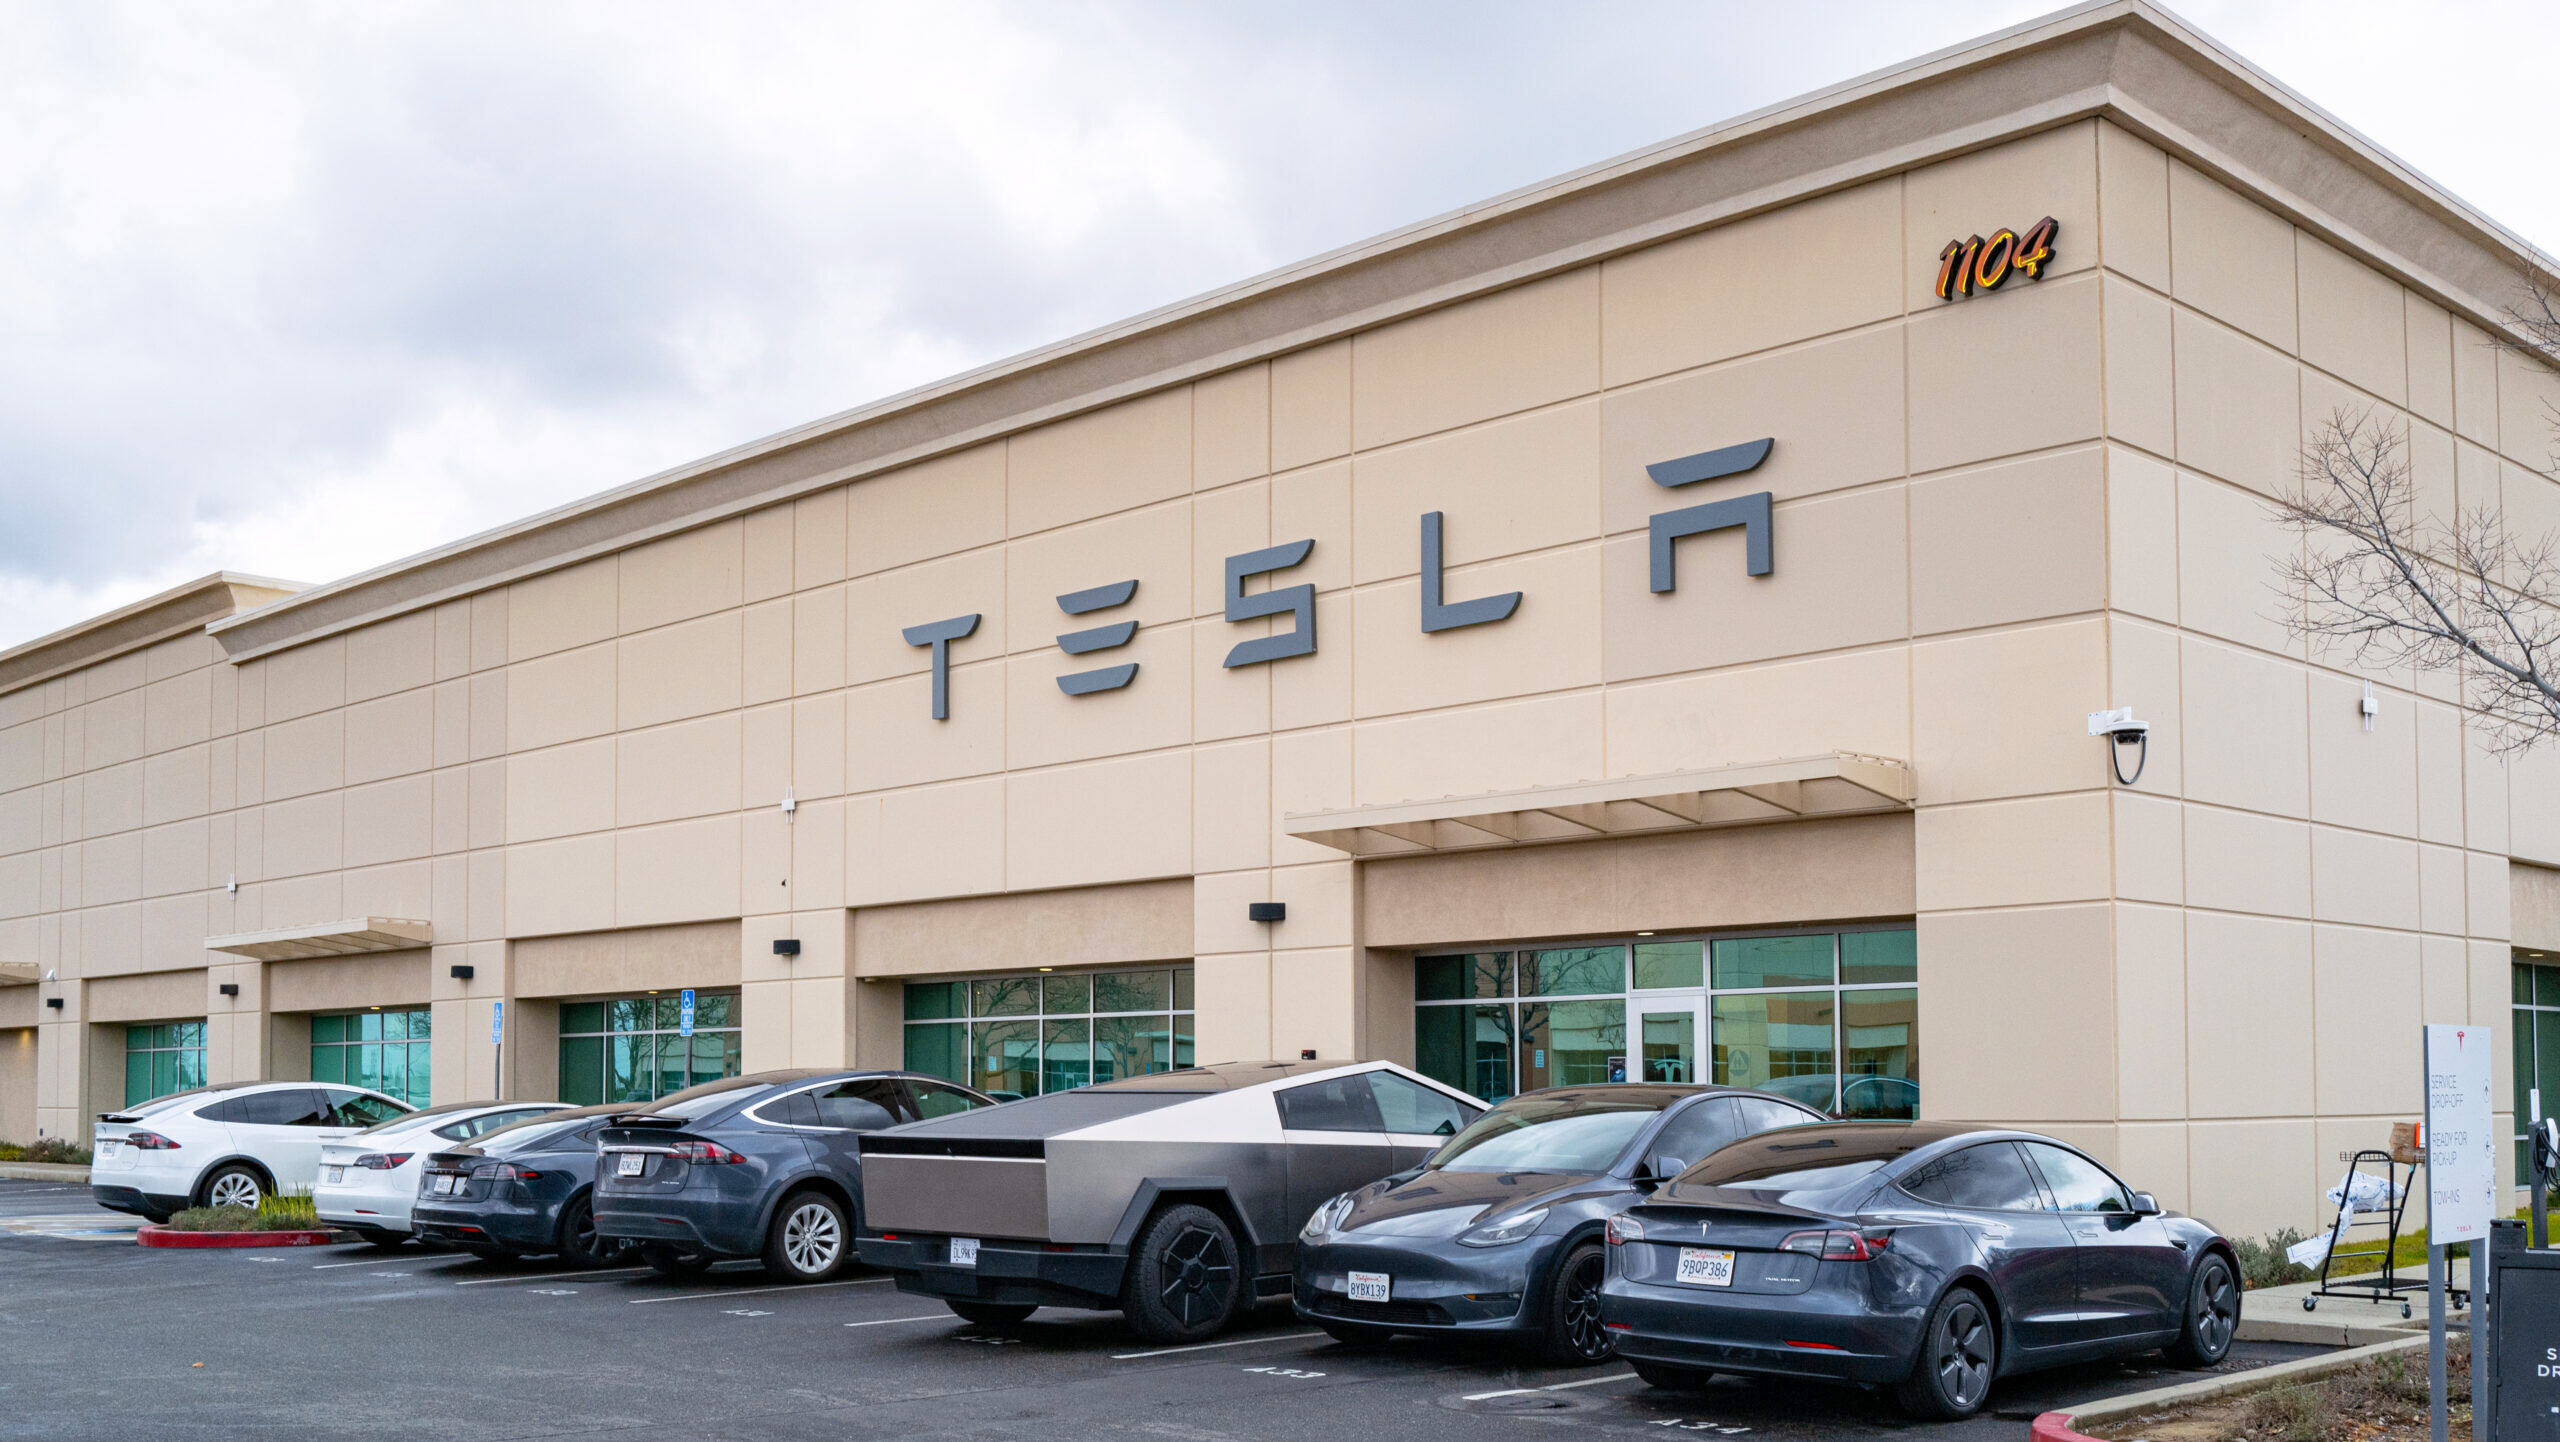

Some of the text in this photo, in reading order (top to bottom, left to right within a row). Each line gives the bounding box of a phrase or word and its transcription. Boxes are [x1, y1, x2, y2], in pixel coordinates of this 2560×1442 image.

[1936, 216, 2059, 301] 1104
[902, 437, 1775, 720] TESLA
[2431, 1074, 2457, 1089] SERVICE
[2432, 1093, 2464, 1109] DROP-OFF
[2432, 1131, 2468, 1147] READY FOR
[2432, 1151, 2457, 1167] PICK-UP
[2433, 1189, 2461, 1206] TOW-INS
[1350, 1282, 1387, 1298] 8YBX139
[1241, 1366, 1327, 1379] A33
[1646, 1418, 1752, 1434] A34
